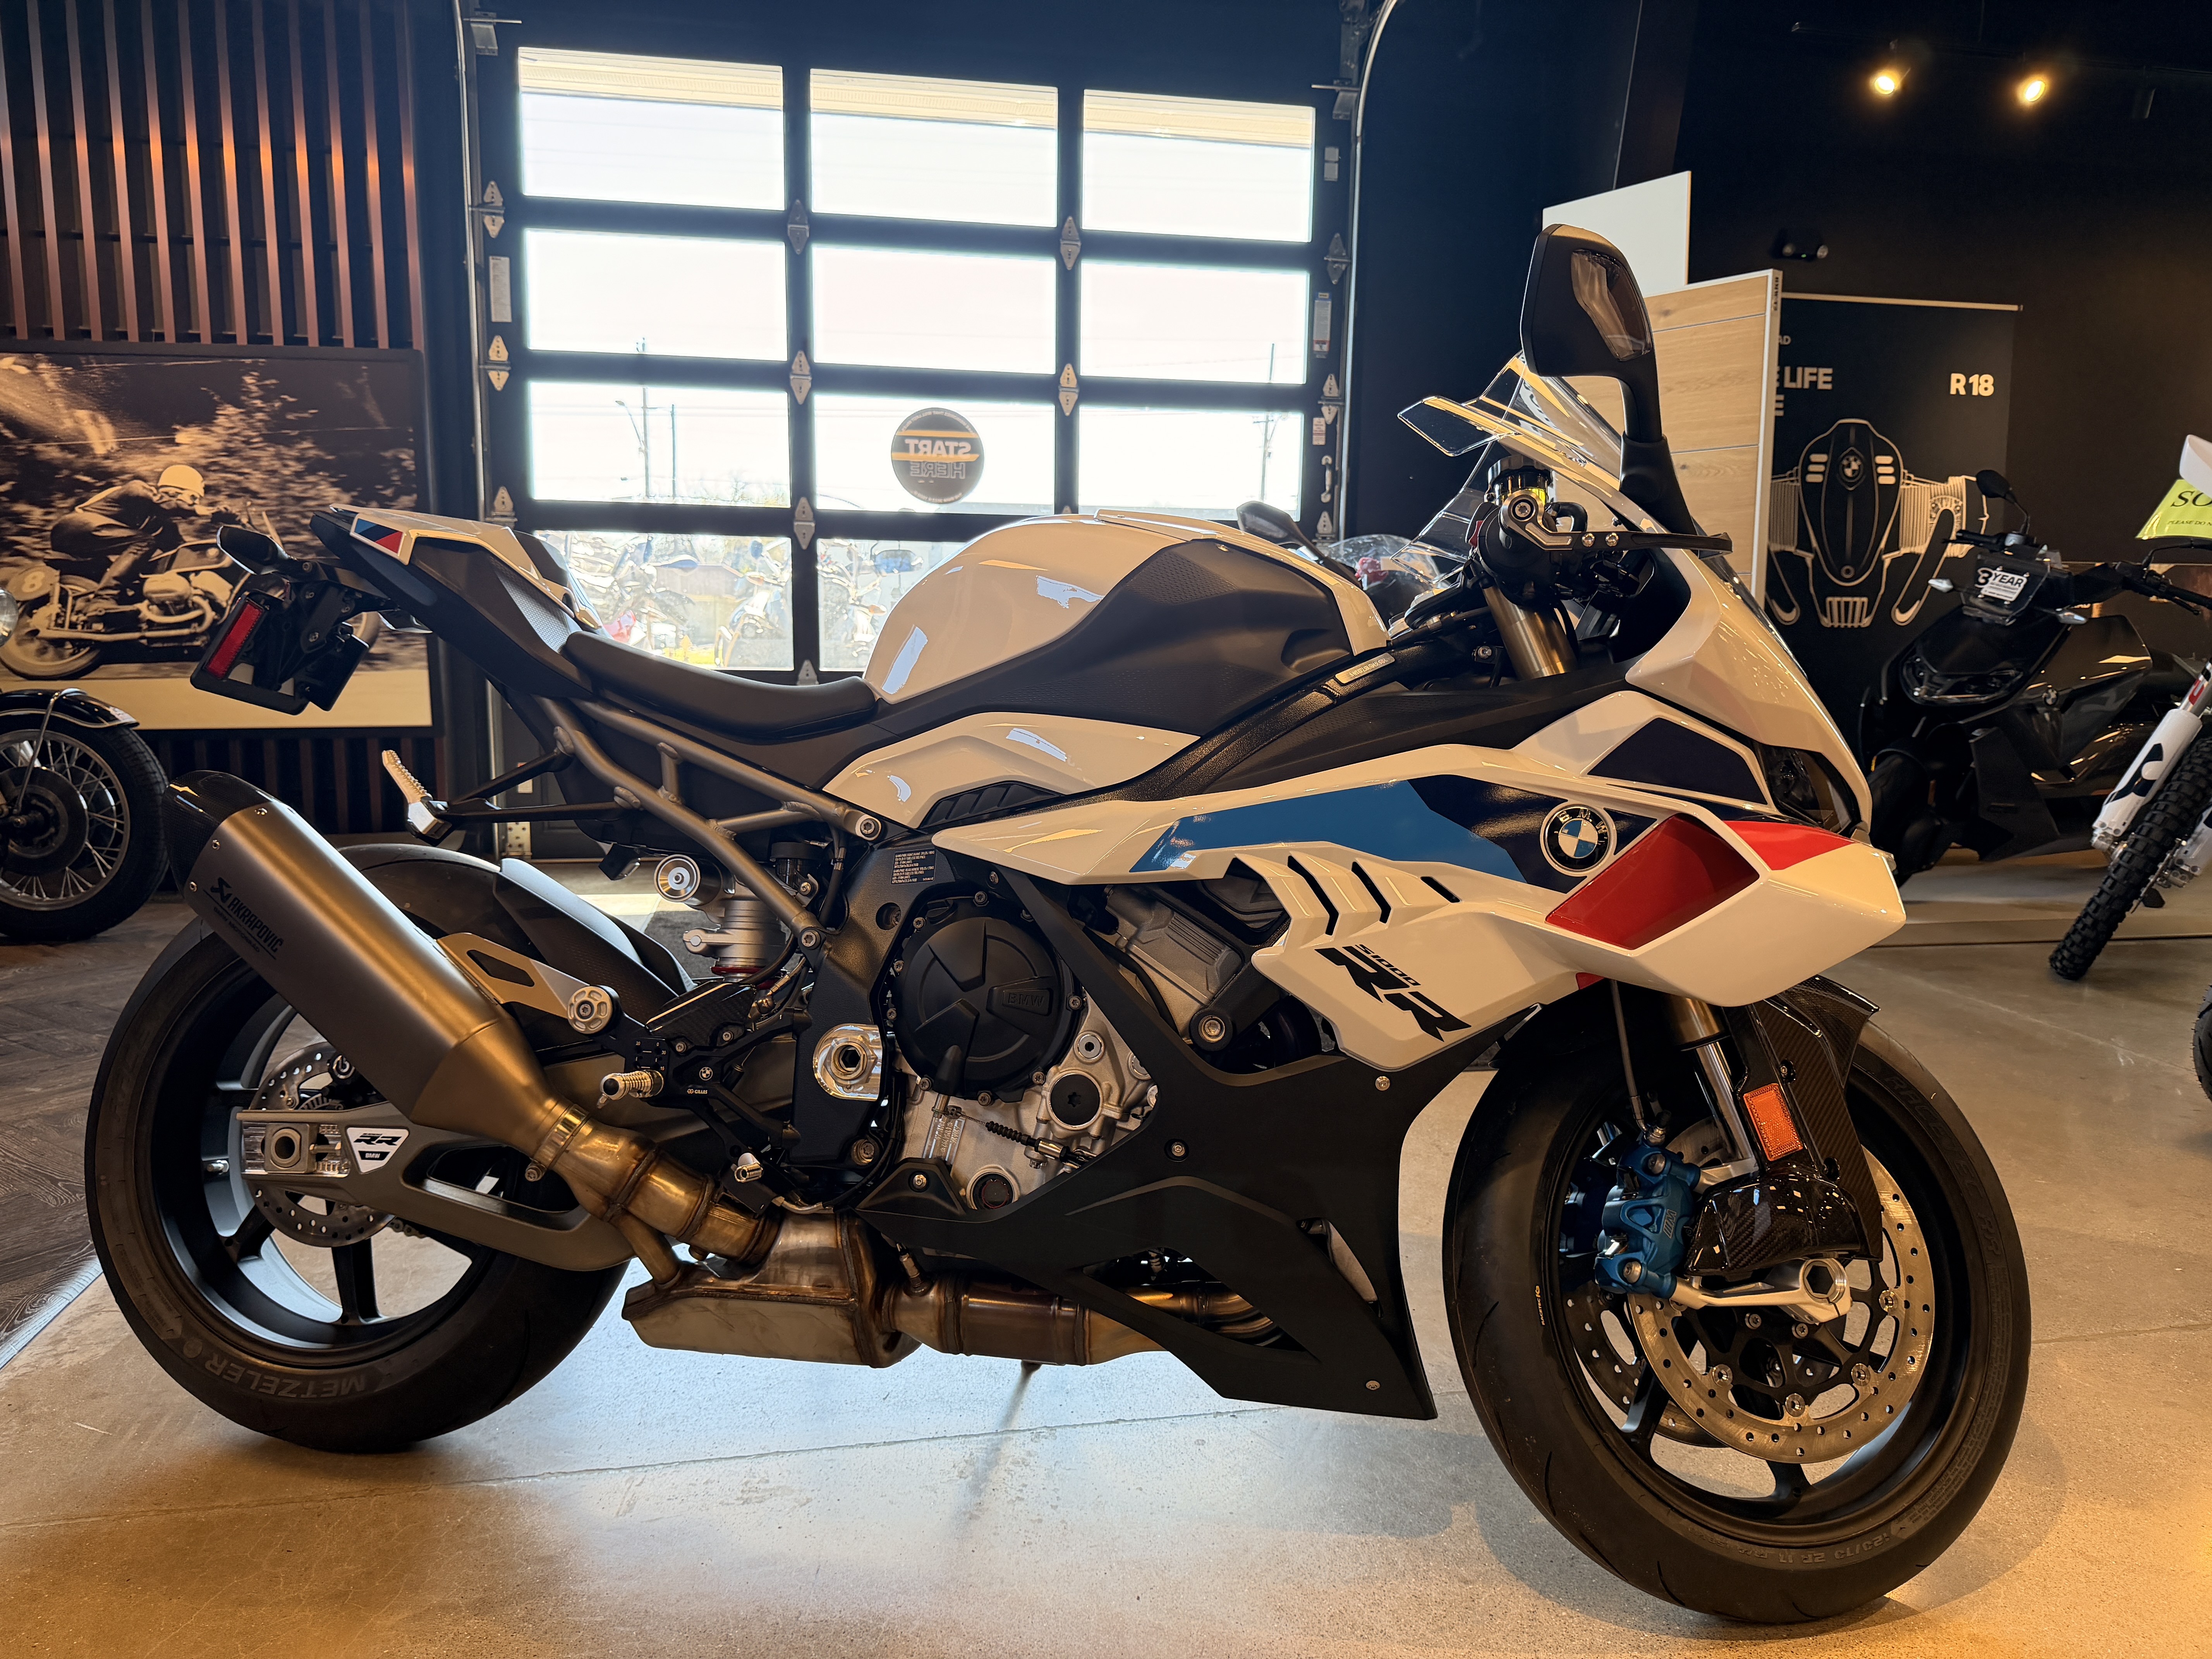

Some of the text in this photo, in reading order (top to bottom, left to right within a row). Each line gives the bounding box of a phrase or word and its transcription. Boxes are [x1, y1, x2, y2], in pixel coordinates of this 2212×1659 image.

[1783, 366, 1833, 390] LIFE
[1975, 569, 2024, 587] 3 YEAR
[1557, 808, 1607, 835] BMW
[1354, 944, 1421, 986] S1000
[1008, 992, 1045, 1006] BMW
[1314, 946, 1472, 1042] RR
[205, 1354, 366, 1398] METZELER
